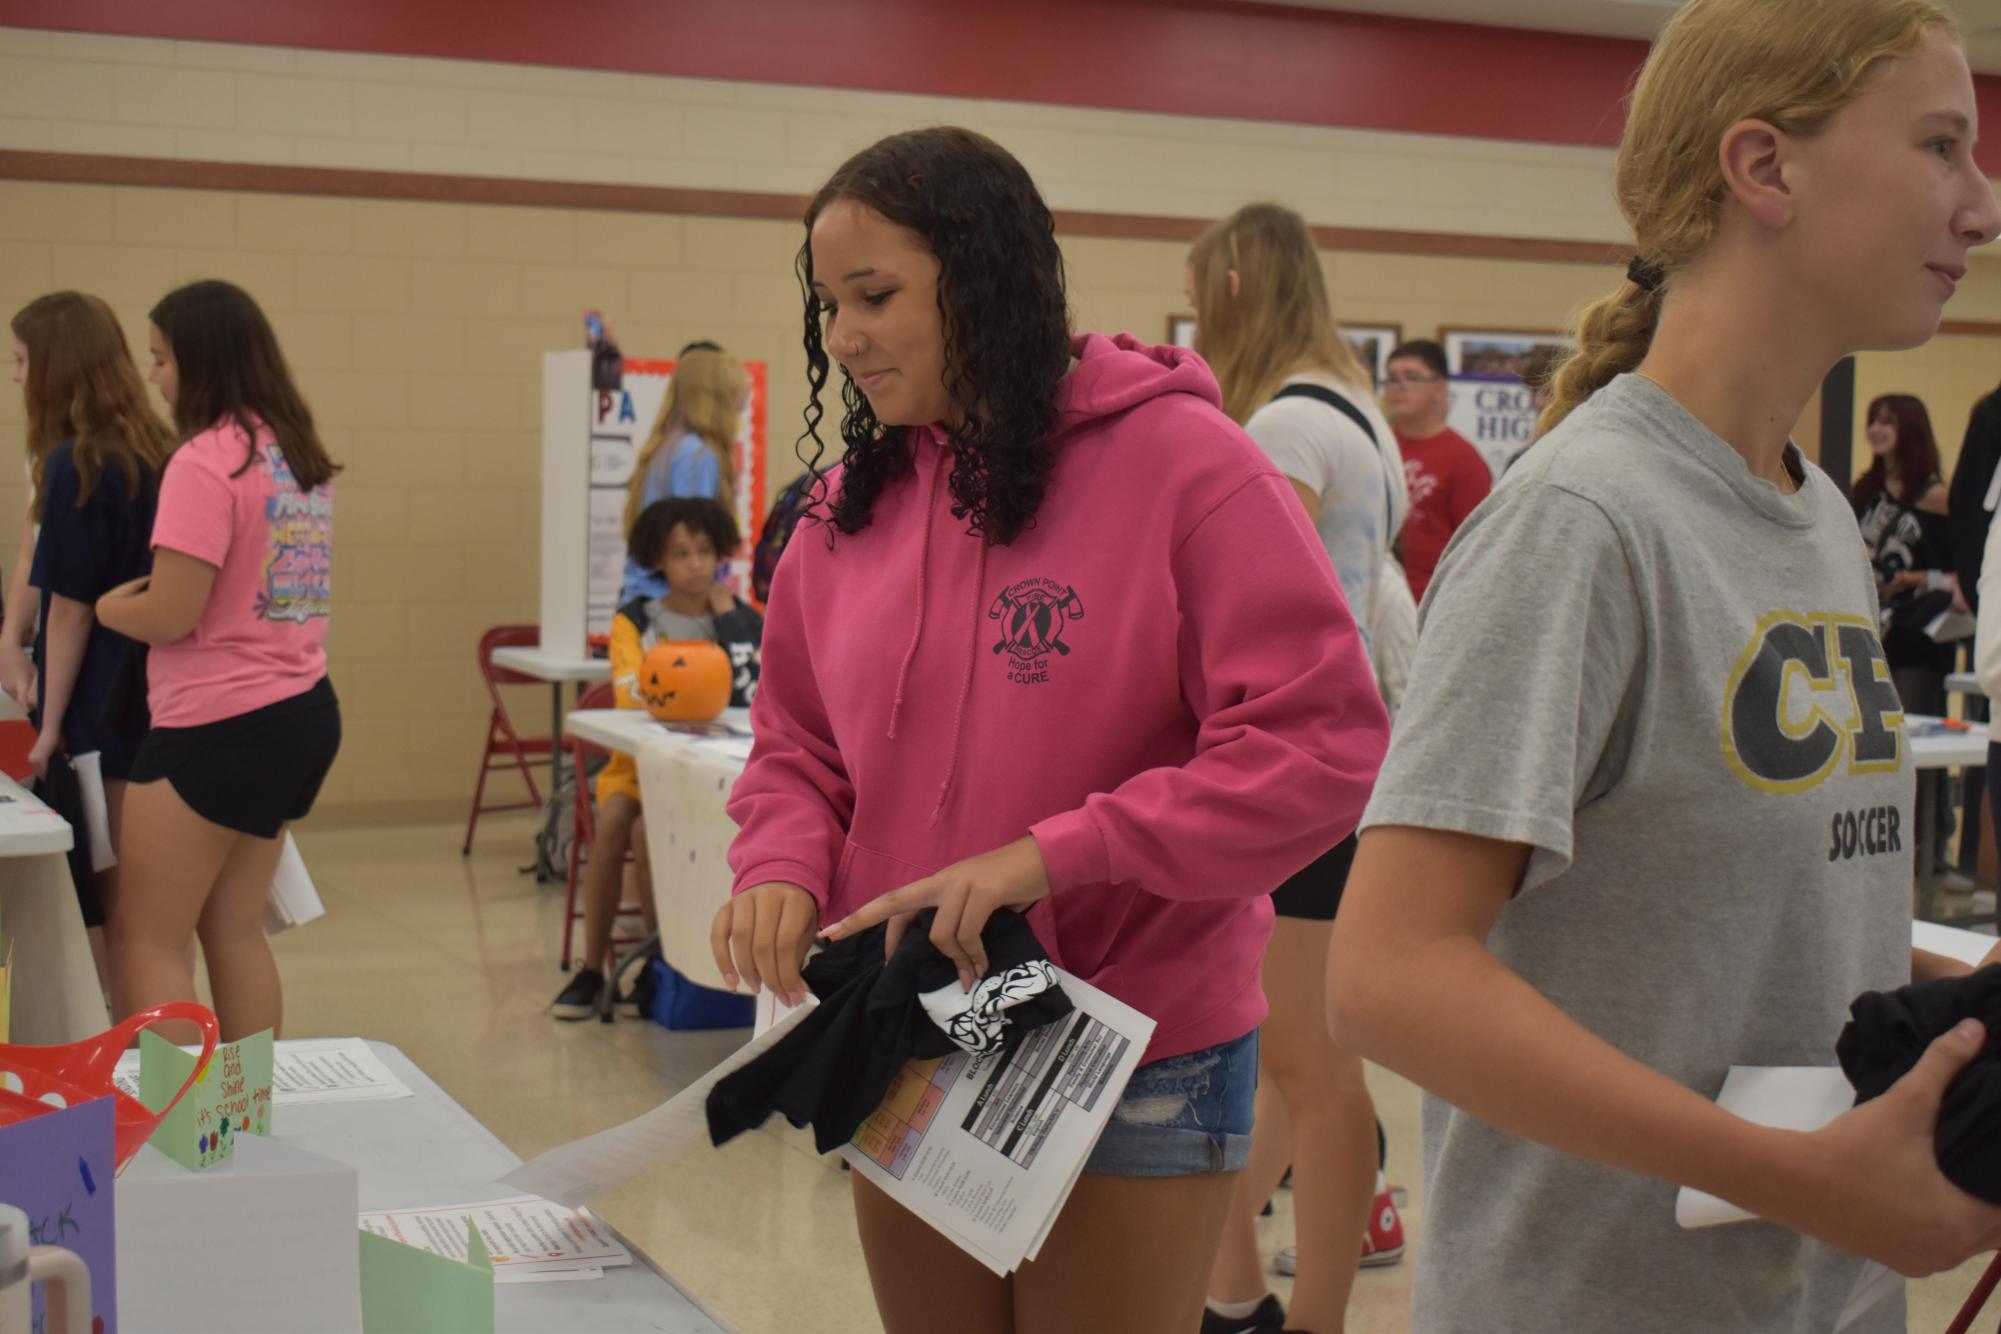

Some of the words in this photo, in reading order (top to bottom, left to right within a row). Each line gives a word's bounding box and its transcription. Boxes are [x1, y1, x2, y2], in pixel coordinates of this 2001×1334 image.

[1475, 389, 1534, 413] CRO
[1477, 416, 1530, 441] HIG
[1008, 578, 1041, 597] CROWN
[1043, 578, 1068, 597] POINT
[1008, 657, 1032, 671] Hope
[1034, 659, 1048, 669] for
[1014, 671, 1049, 684] CURE
[1829, 805, 1902, 862] SOCCER
[1061, 1036, 1076, 1057] Lunch
[223, 1060, 241, 1078] and
[965, 1052, 985, 1081] BLOC
[980, 1081, 994, 1101] Lunch
[1020, 1106, 1034, 1126] Lunch
[29, 1201, 80, 1244] ACK
